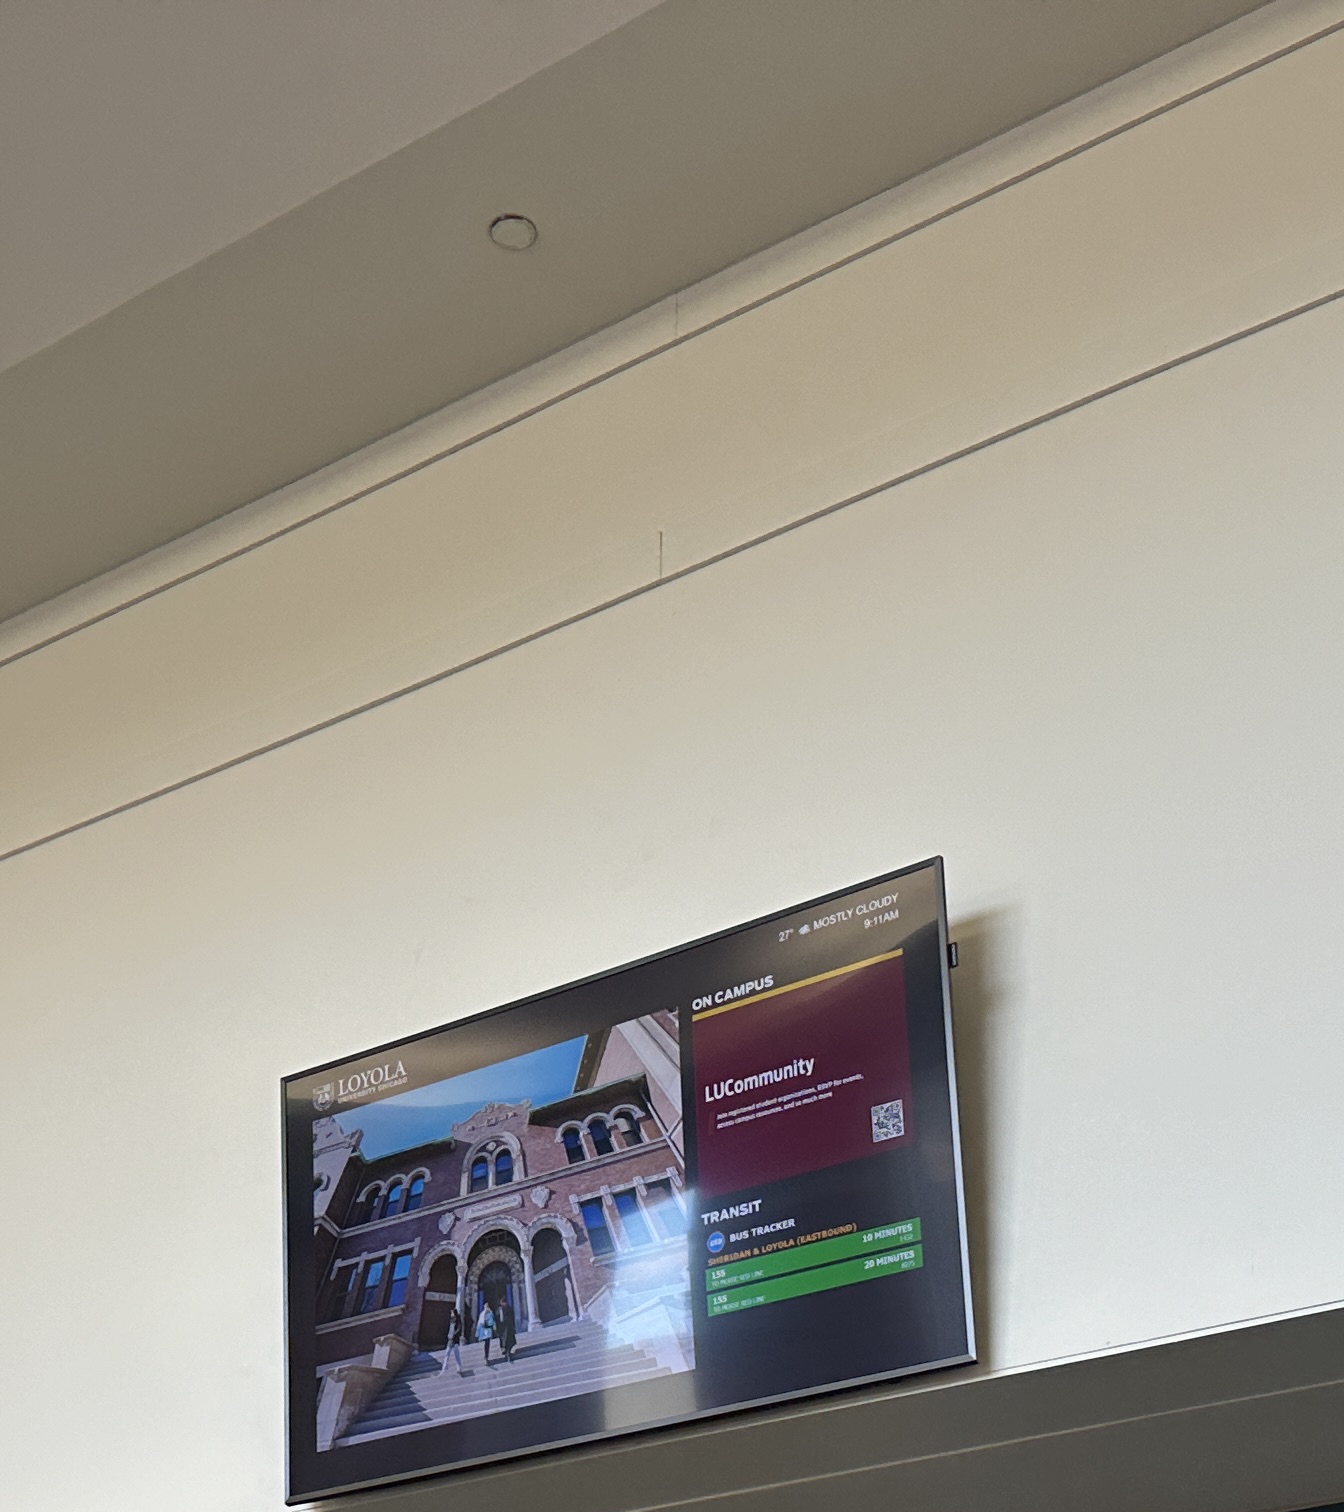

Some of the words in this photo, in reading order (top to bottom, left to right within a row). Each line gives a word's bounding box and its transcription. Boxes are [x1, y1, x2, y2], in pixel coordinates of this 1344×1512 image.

[813, 907, 854, 931] MOSTLY
[856, 892, 899, 916] CLOUDY
[863, 909, 899, 929] 9:11AM
[692, 994, 712, 1011] ON
[714, 975, 774, 1002] CAMPUS
[338, 1060, 407, 1096] LOYOLA
[704, 1057, 815, 1103] LUCommunity
[701, 1199, 762, 1226] TRANSIT
[729, 1230, 749, 1243] BUS
[751, 1218, 796, 1237] TRACKER
[762, 1238, 795, 1252] LOYOLA
[796, 1222, 857, 1246] (EASTBOUND)
[862, 1233, 873, 1243] 10
[874, 1223, 913, 1239] MINUTES
[864, 1259, 875, 1270] 20
[876, 1250, 915, 1266] MINUTES
